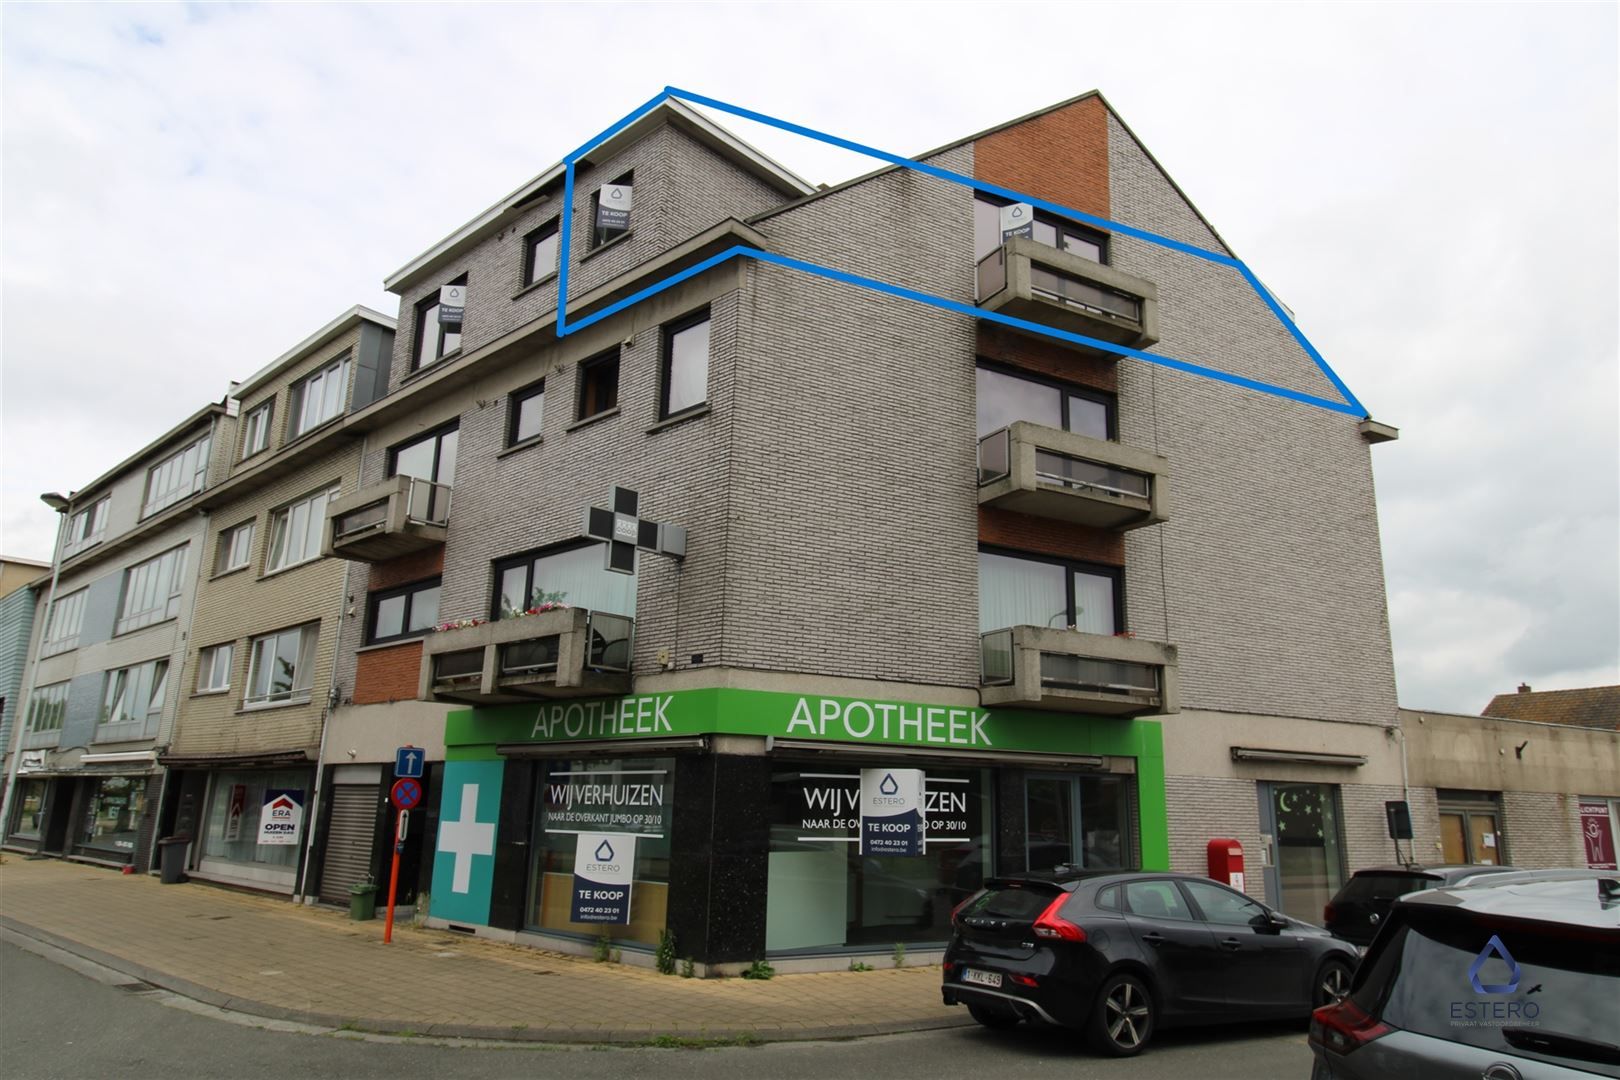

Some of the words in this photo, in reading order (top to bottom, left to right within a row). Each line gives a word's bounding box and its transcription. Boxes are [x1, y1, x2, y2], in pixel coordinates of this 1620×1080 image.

[531, 695, 674, 738] APOTHEEK
[786, 697, 992, 746] APOTHEEK
[575, 784, 664, 806] VERHUIZEN
[803, 787, 841, 816] WIJ
[873, 797, 905, 805] ESTERO
[548, 812, 565, 822] NAAR
[566, 812, 574, 822] DE
[575, 812, 609, 822] OVERKANT
[609, 813, 632, 825] JUMBO
[632, 814, 644, 824] OP
[644, 814, 662, 825] 30/10
[802, 818, 830, 829] NAAR
[832, 818, 846, 829] DE
[931, 820, 944, 830] OP
[946, 820, 967, 831] 30/10
[868, 823, 880, 832] TE
[882, 823, 911, 833] KOOP
[586, 863, 621, 872] ESTERO
[578, 890, 591, 899] TE
[593, 890, 624, 900] KOOP
